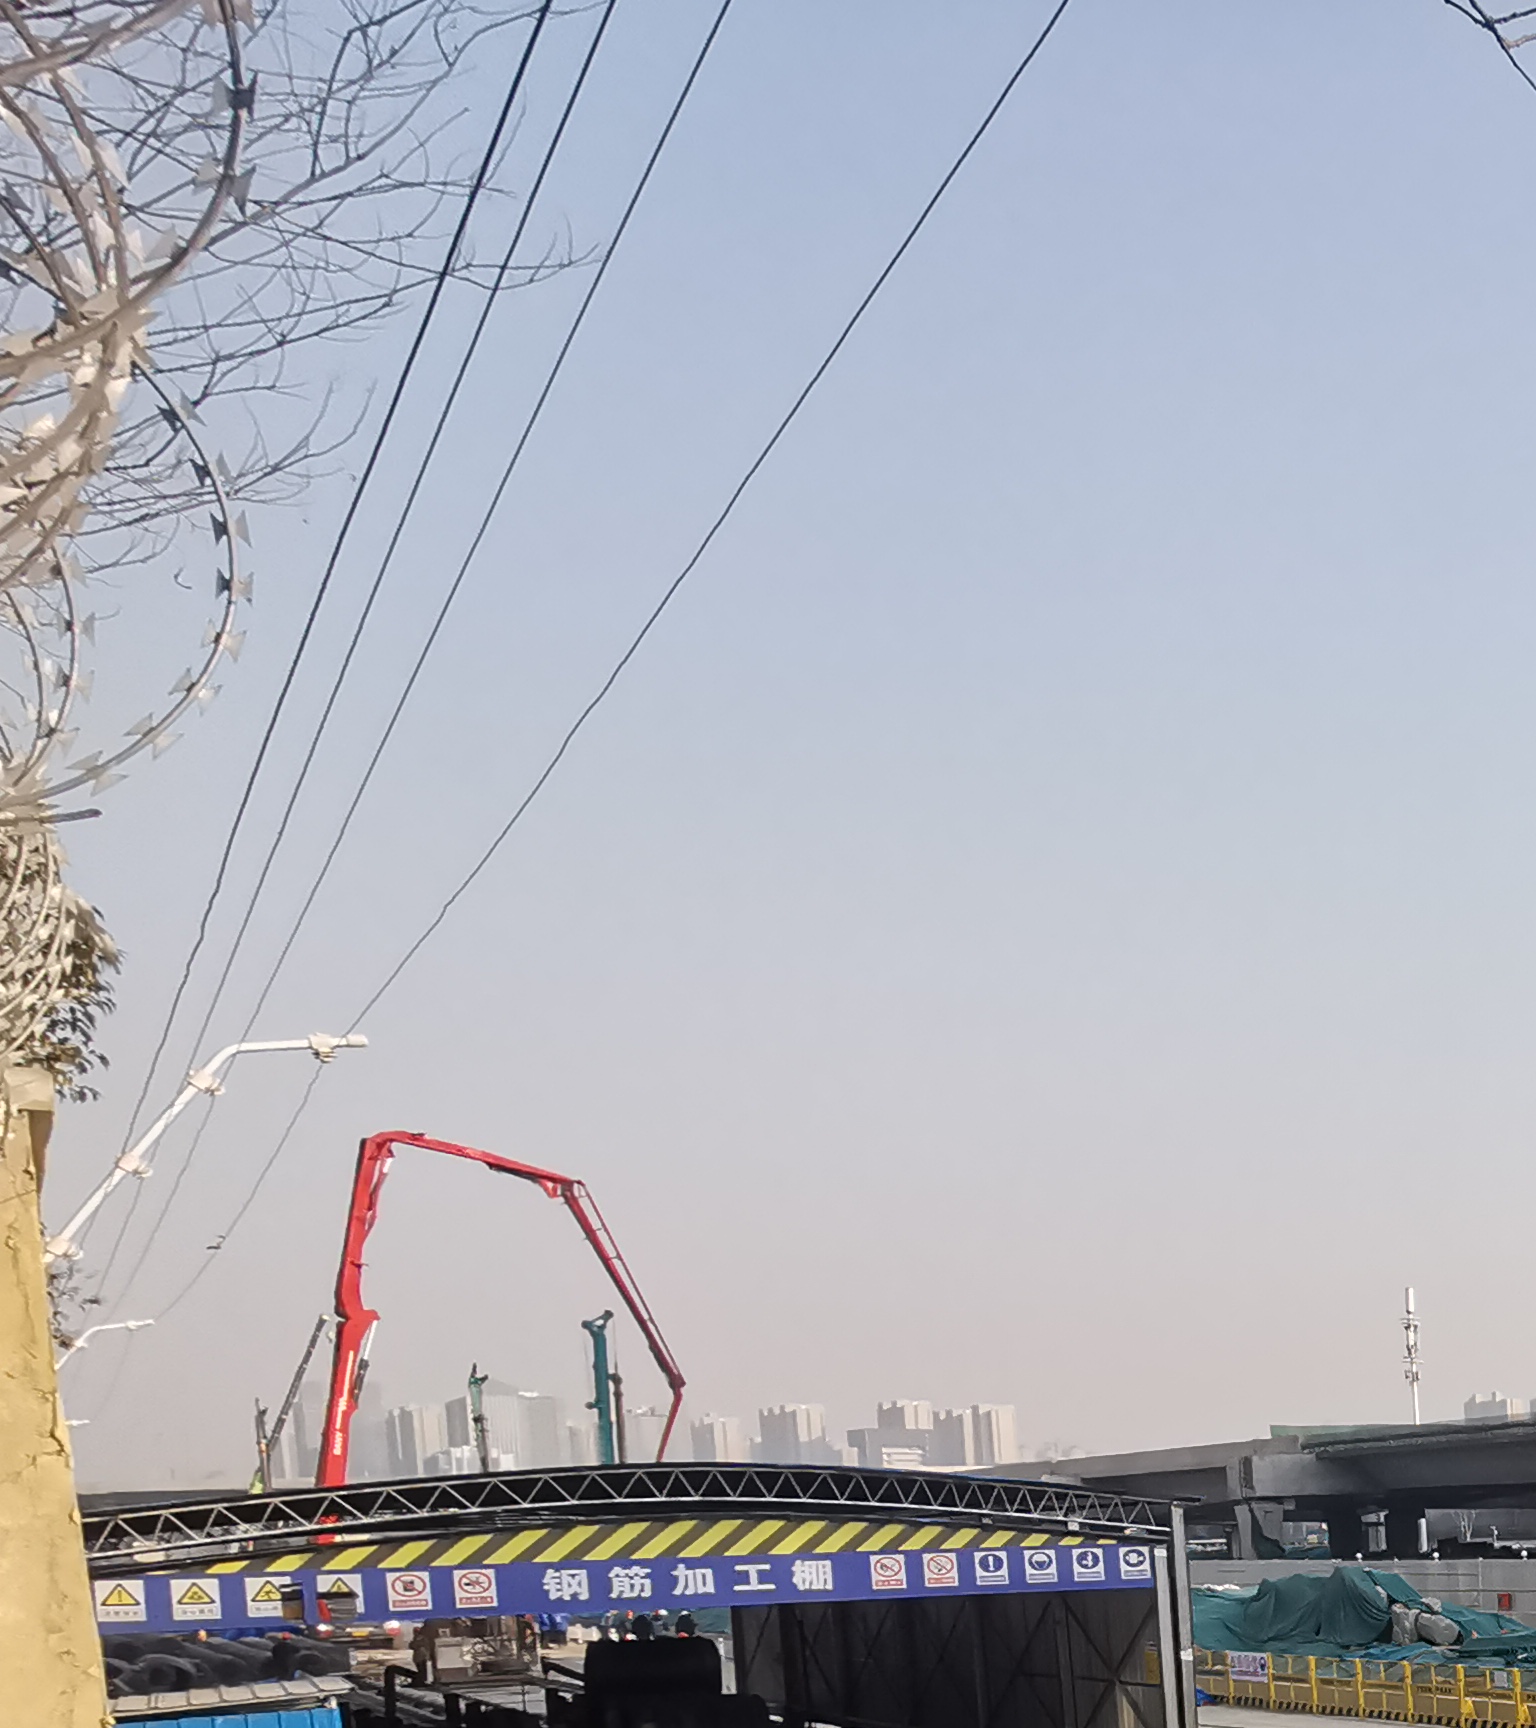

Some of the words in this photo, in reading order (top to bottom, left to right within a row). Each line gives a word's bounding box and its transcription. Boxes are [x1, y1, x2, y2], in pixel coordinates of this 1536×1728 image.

[542, 1559, 834, 1600] 钢筋加工棚
